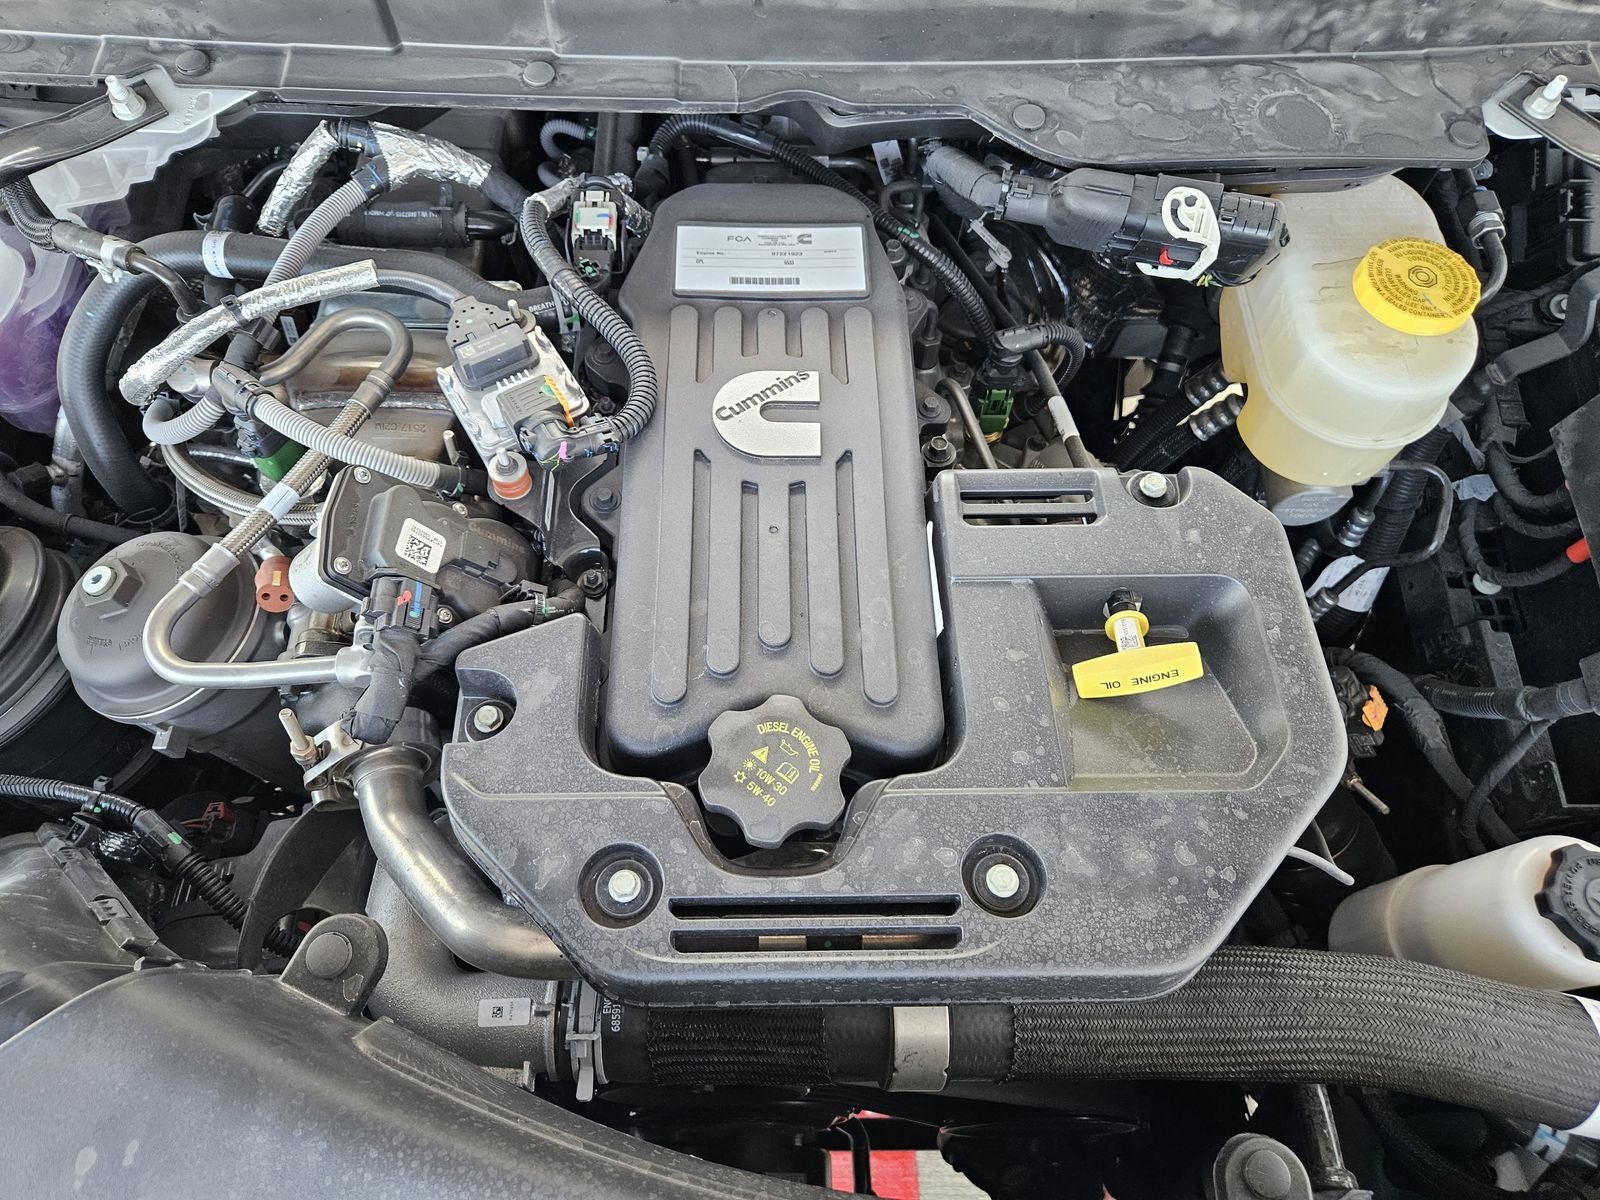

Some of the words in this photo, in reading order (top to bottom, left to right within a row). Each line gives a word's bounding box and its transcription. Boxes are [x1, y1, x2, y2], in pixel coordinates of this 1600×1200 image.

[715, 371, 810, 421] Cummins
[1100, 681, 1121, 690] OIL
[1131, 669, 1179, 686] ENGINE
[757, 722, 790, 734] DIESEL
[790, 727, 819, 757] ENGINE
[809, 759, 821, 773] OIL
[746, 781, 776, 807] 5W-40
[756, 768, 788, 796] 10W-30
